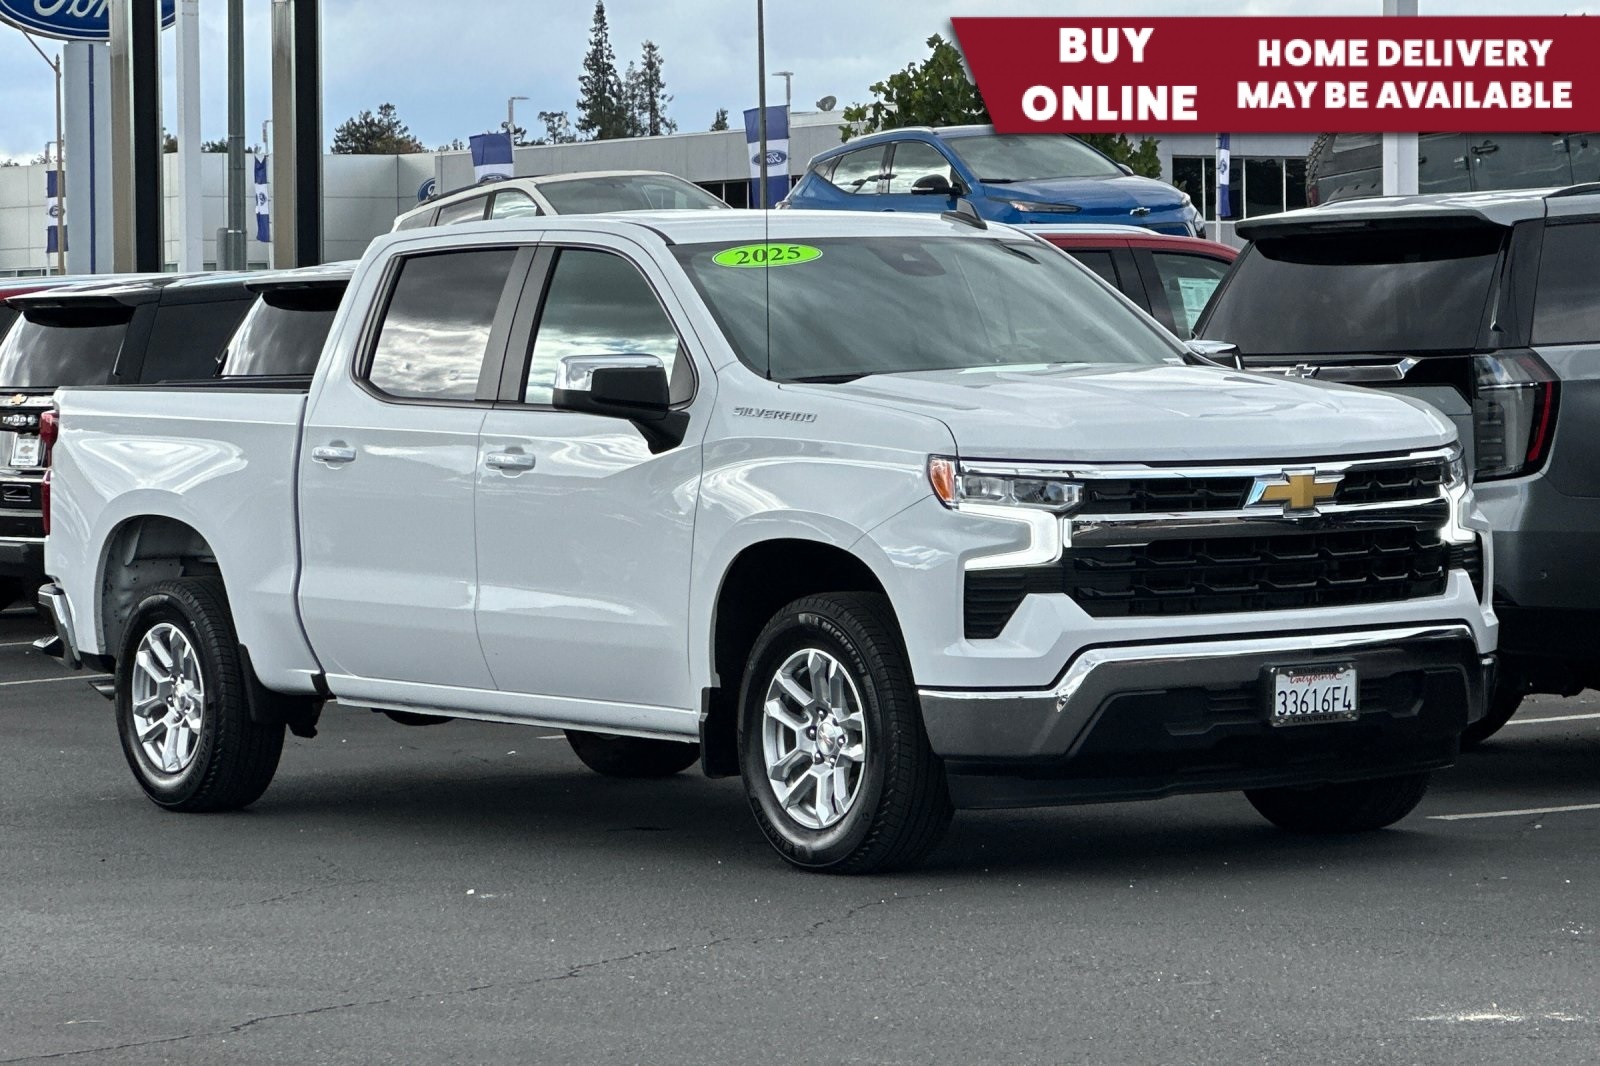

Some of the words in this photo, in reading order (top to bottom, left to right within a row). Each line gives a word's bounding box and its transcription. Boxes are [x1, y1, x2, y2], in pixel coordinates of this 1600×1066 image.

[735, 246, 801, 265] 2025
[732, 406, 818, 423] SILVERADO
[1277, 685, 1352, 716] 33616F4
